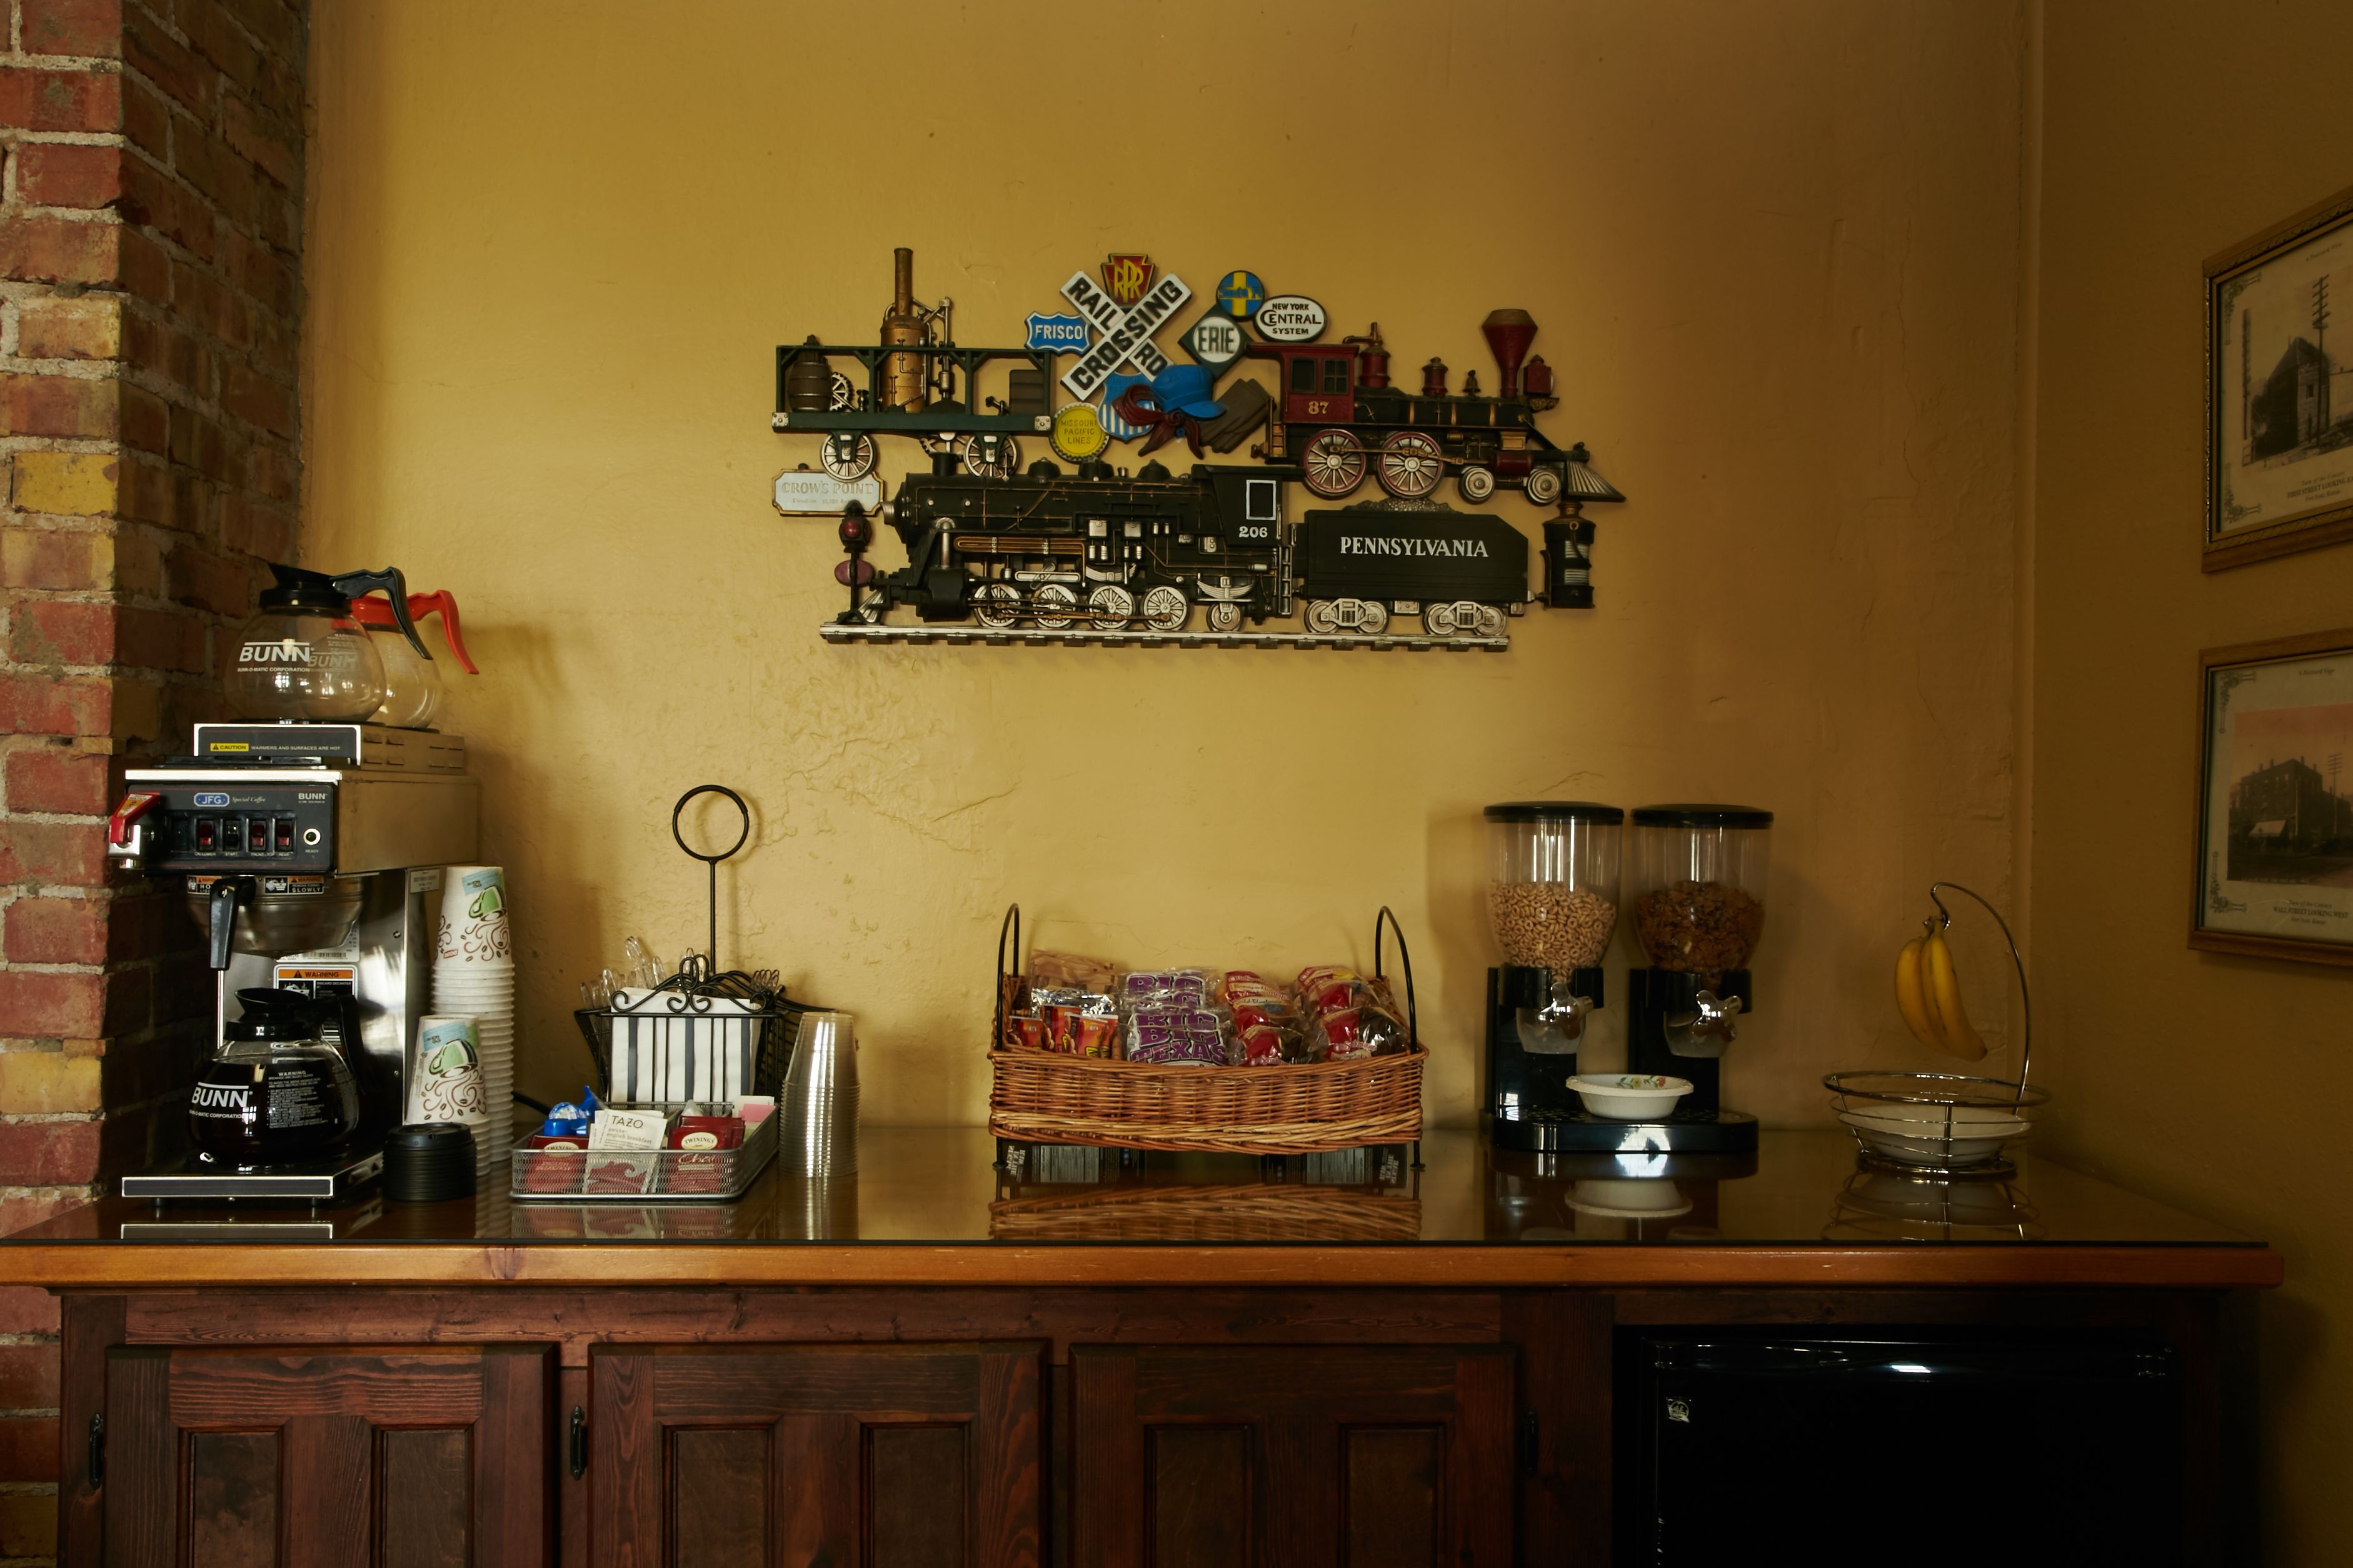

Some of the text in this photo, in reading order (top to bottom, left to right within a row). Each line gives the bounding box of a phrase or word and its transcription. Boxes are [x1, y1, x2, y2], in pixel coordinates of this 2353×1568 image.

[1067, 277, 1121, 331] RAIL
[1260, 309, 1322, 326] CENTRAL
[1035, 324, 1083, 340] FRISCO
[1070, 279, 1183, 391] CROSSING
[1198, 326, 1234, 354] ERIE
[1308, 401, 1330, 415] 87
[1064, 427, 1095, 436] PACIFIC
[781, 480, 874, 494] CROW'S POINT
[1238, 526, 1268, 538] 206
[1340, 536, 1489, 557] PENNSYLVANIA
[239, 646, 310, 662] BUNN
[201, 796, 222, 804] JFG
[1138, 1027, 1220, 1047] BIG
[1130, 1041, 1227, 1066] TEXAS
[191, 1086, 249, 1108] BUNN
[612, 1115, 643, 1129] TAZO
[627, 1134, 652, 1144] breakfast
